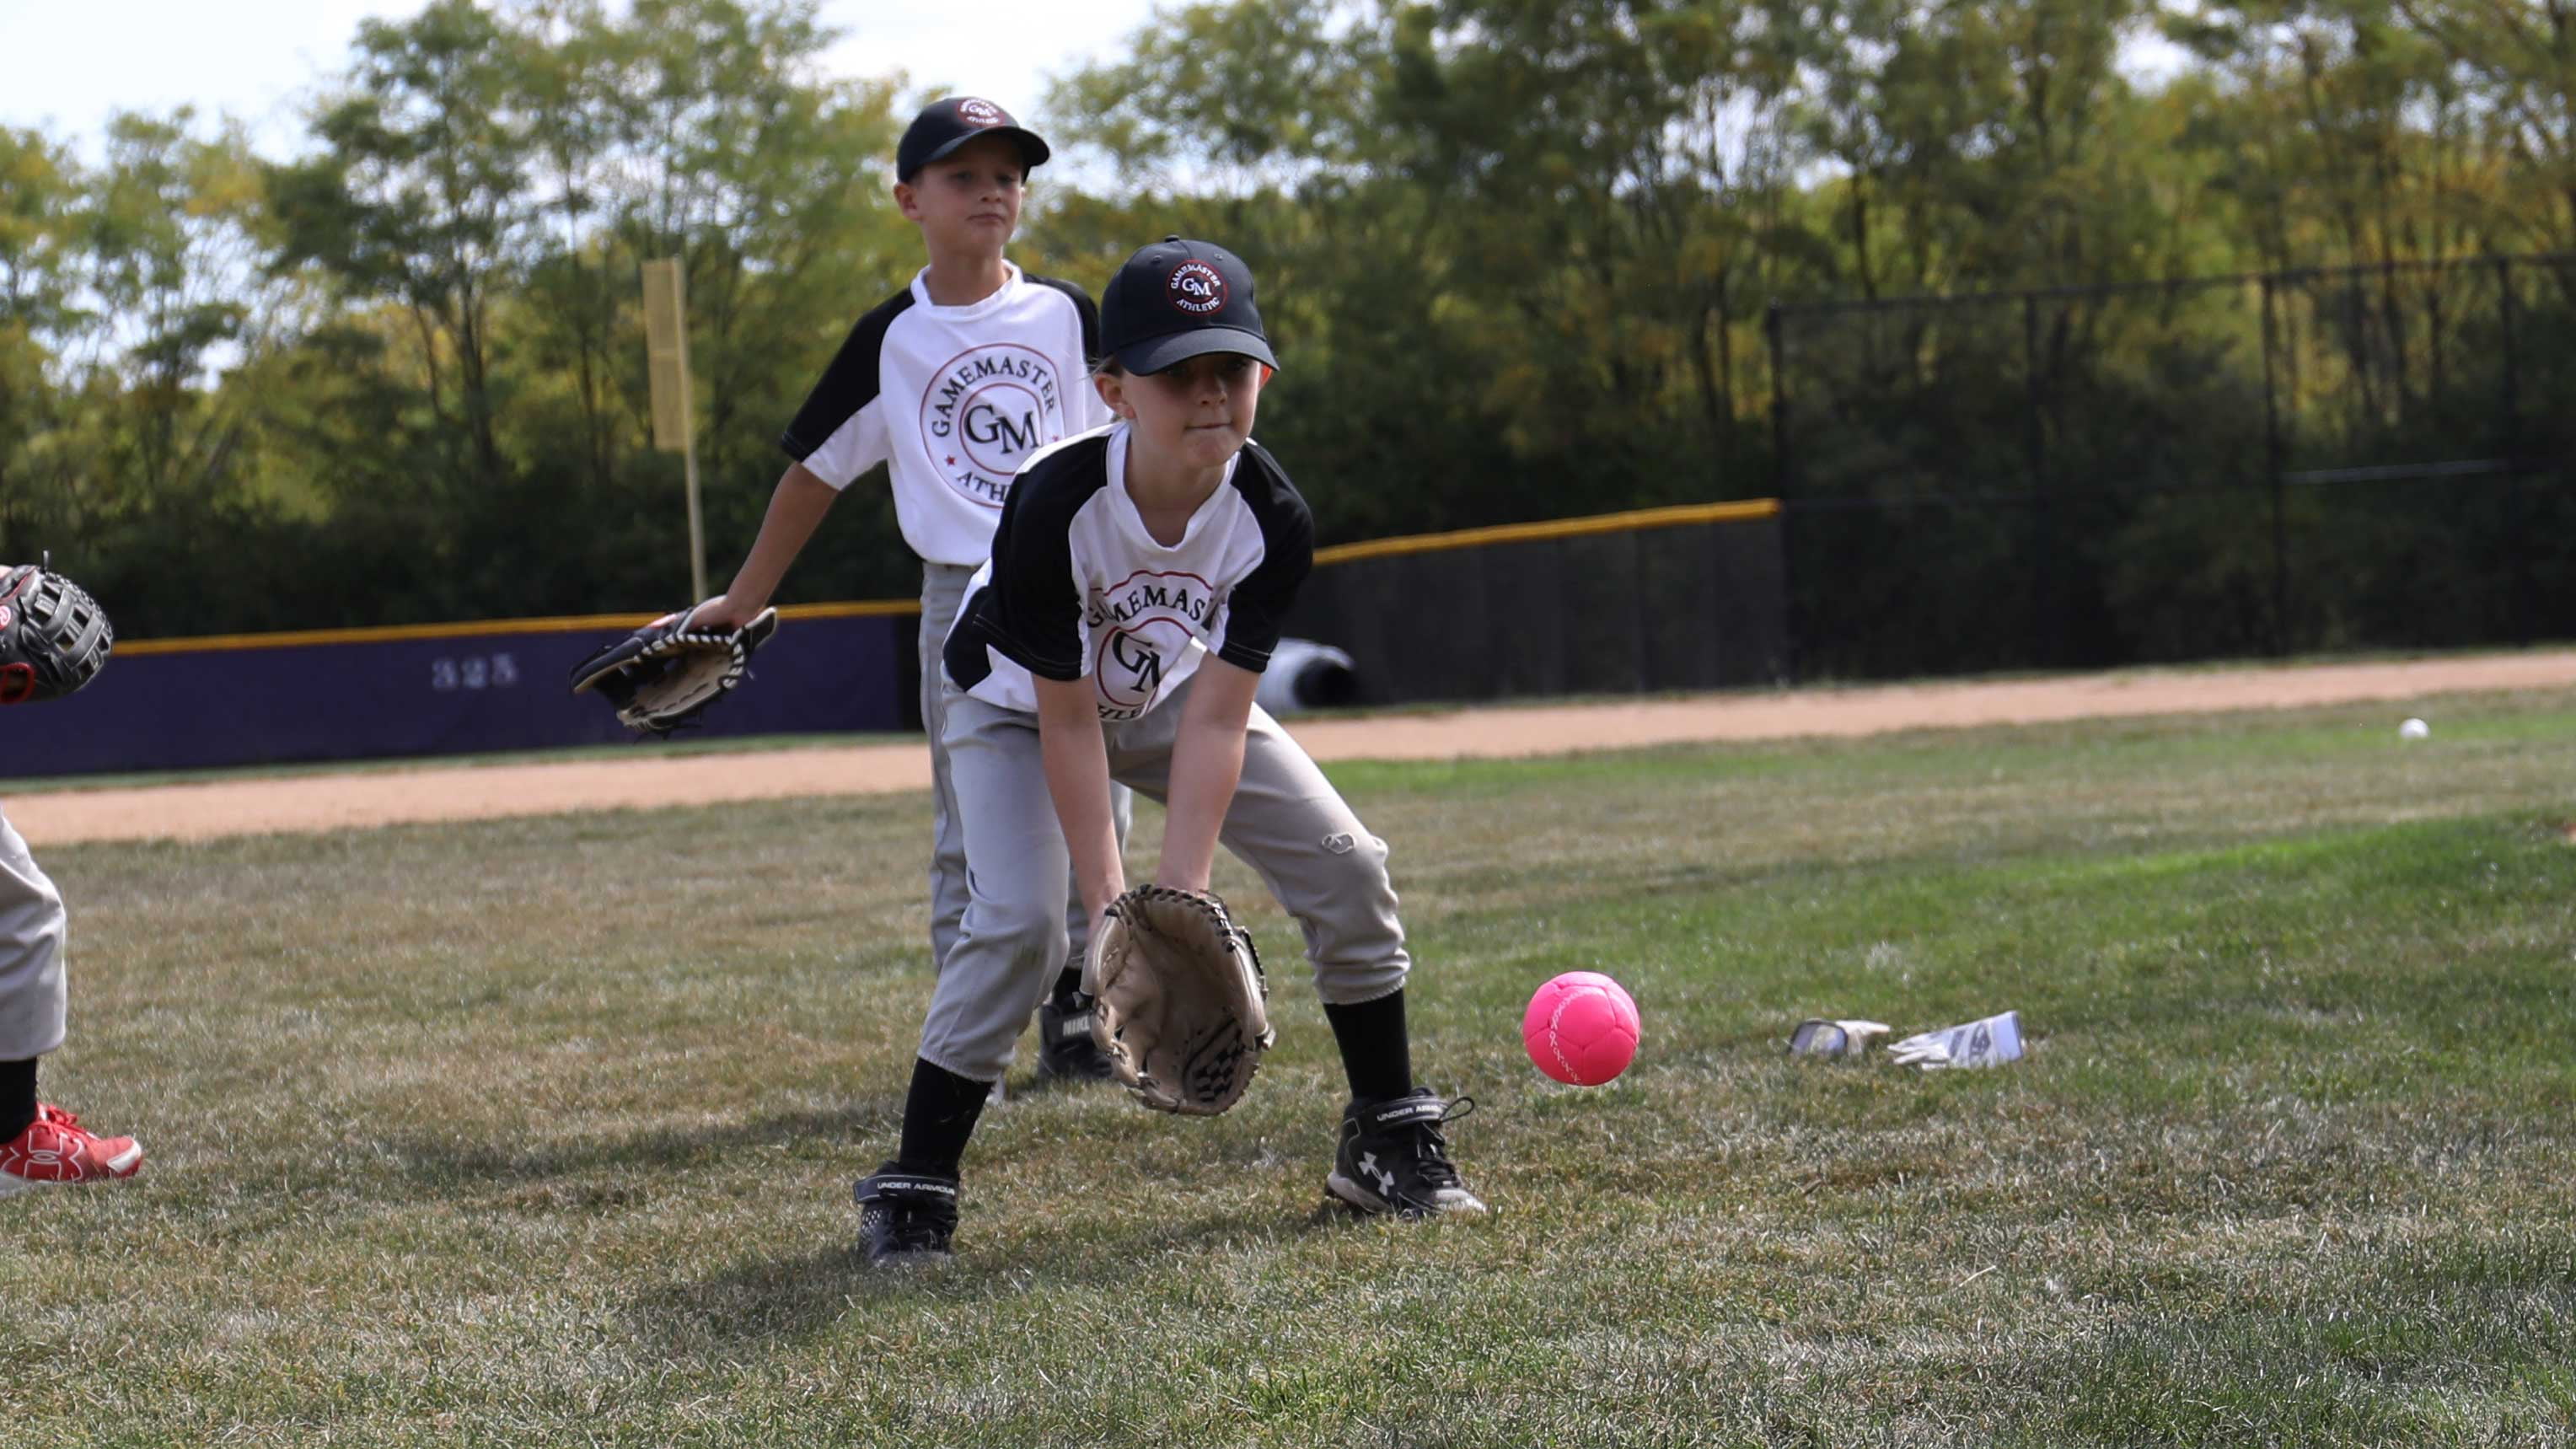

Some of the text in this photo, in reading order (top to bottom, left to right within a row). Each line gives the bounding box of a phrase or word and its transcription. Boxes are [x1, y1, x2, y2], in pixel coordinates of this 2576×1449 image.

[1171, 263, 1221, 289] GAMEMASTER
[1182, 278, 1212, 296] GM
[1177, 297, 1221, 312] ATHLETIC
[931, 355, 1055, 437] GAMEMASTER
[963, 404, 1040, 455] GM
[957, 471, 1006, 502] ATH
[1377, 1107, 1414, 1122] UNDER
[877, 1182, 911, 1190] UNDER
